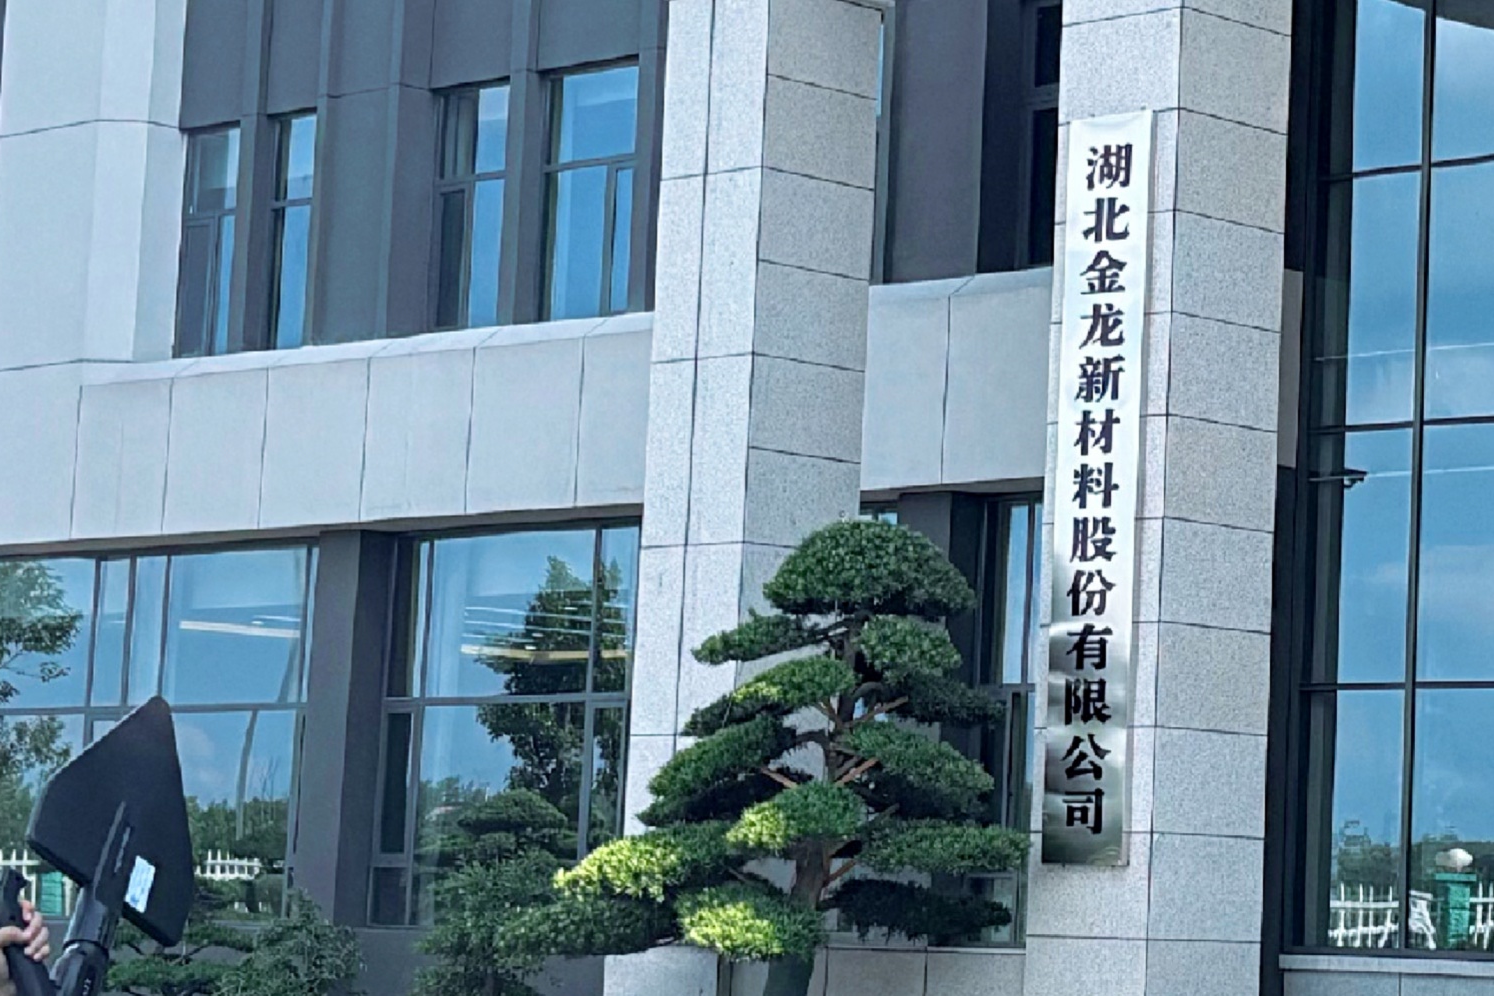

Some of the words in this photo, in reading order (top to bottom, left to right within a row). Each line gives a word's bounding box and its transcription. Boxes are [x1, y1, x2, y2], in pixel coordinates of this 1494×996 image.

[1061, 143, 1132, 834] 湖北金龙新材料股份有限公司
